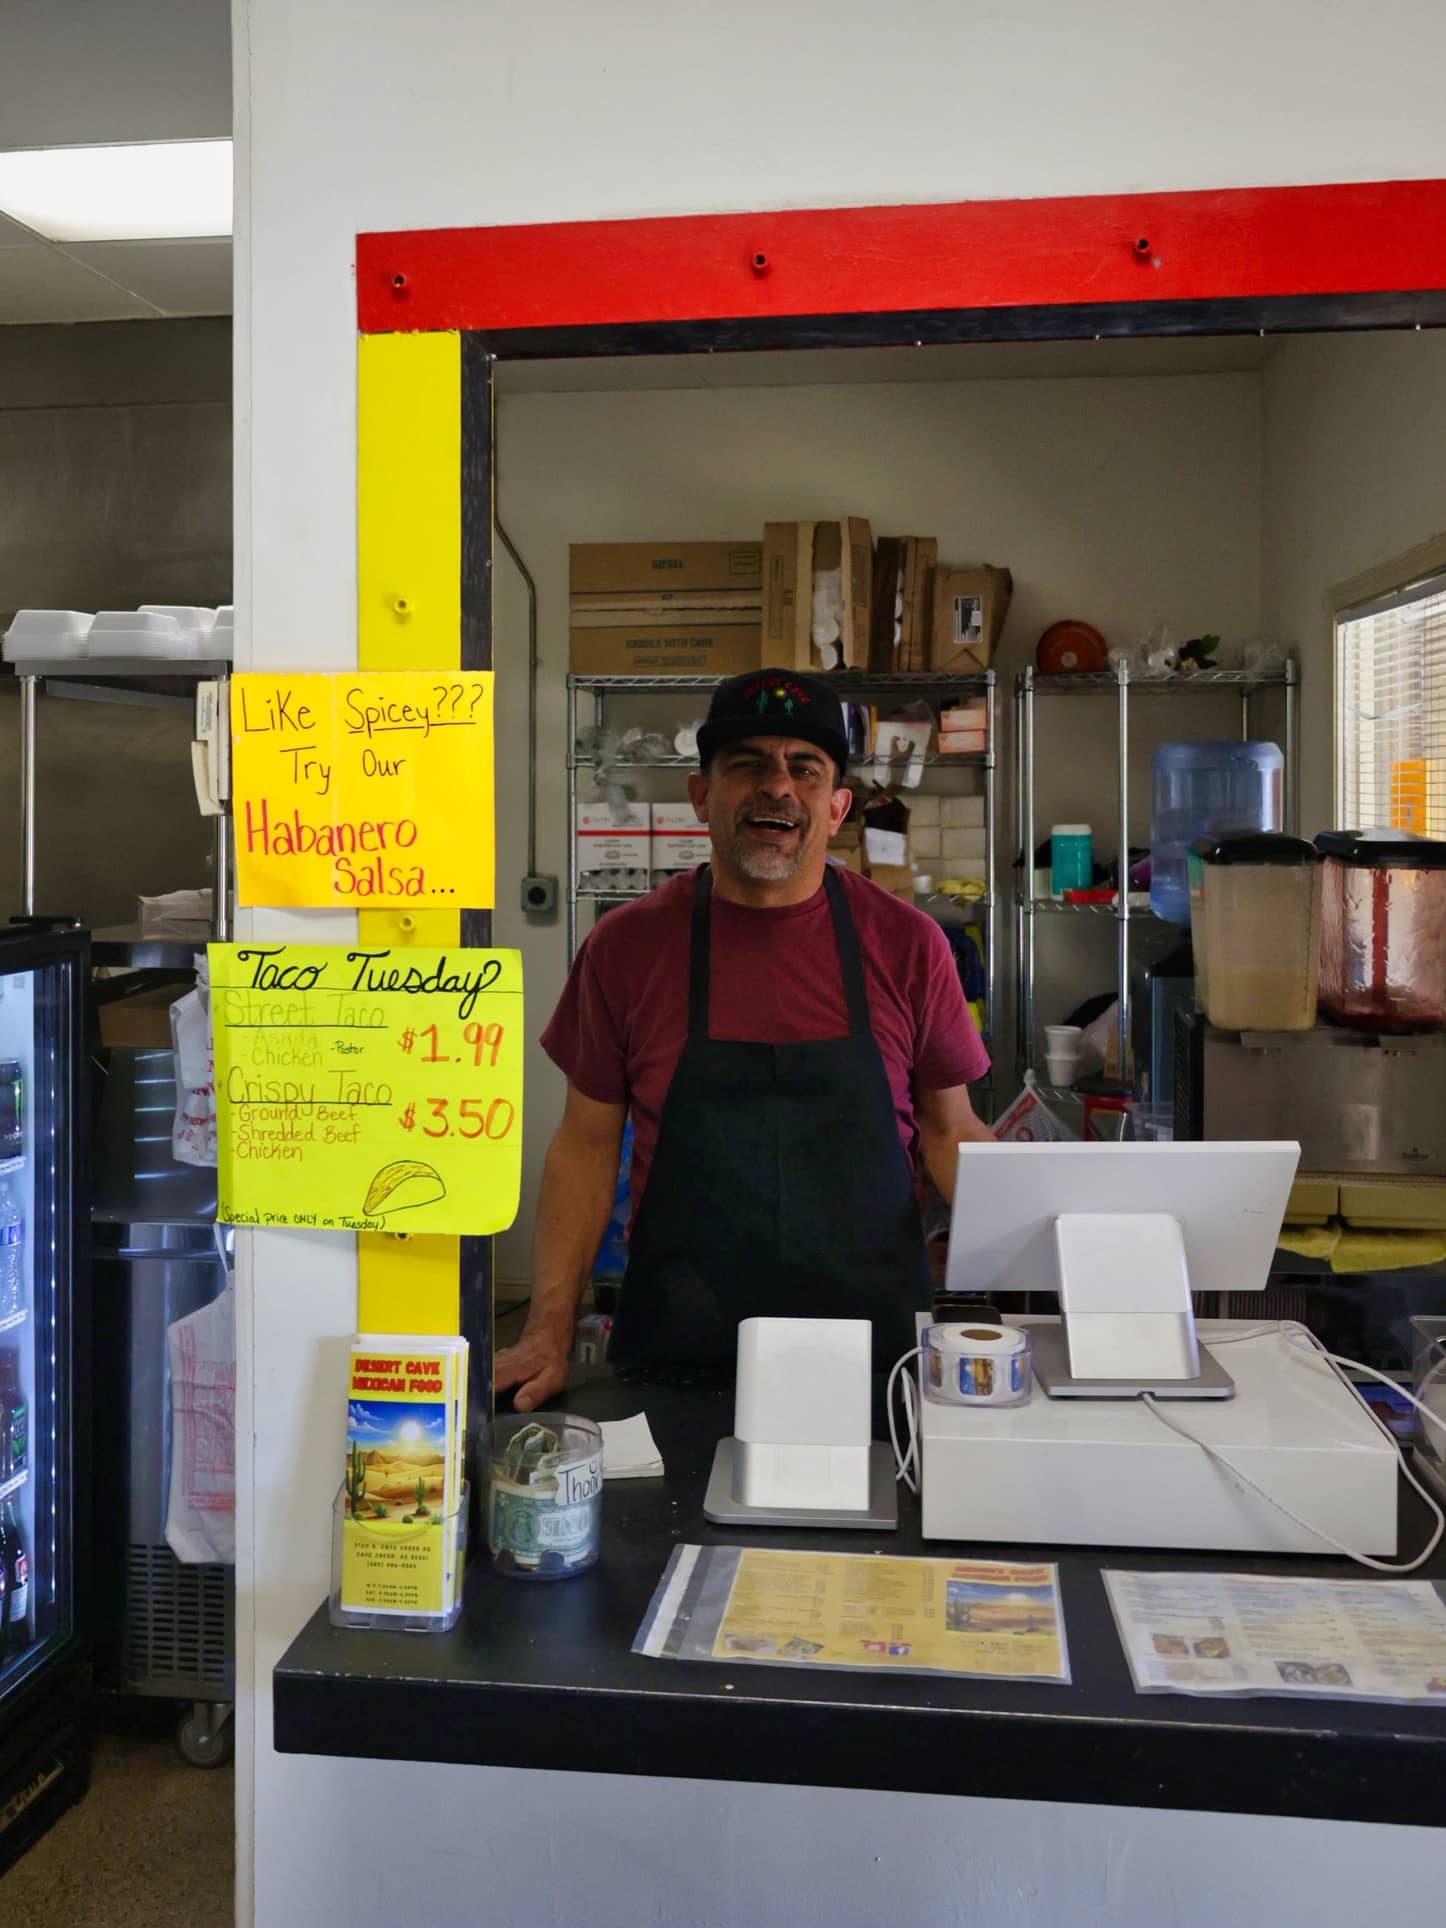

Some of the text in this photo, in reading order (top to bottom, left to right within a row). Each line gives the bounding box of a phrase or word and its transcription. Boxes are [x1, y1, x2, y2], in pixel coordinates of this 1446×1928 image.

[344, 683, 484, 739] Spicey???
[279, 745, 407, 795] Try Our
[245, 798, 417, 857] Habanero
[237, 945, 502, 1020] Taco Tuesday
[223, 989, 385, 1026] Street Taco
[397, 1021, 505, 1067] $1.99
[226, 1065, 393, 1117] Crispy Taco
[316, 1103, 358, 1121] Beef
[323, 1125, 362, 1144] Beef
[398, 1097, 516, 1140] $3.50
[294, 1211, 317, 1226] ONLY
[322, 1217, 335, 1227] on
[351, 1376, 443, 1393] MEXICAN FOOD
[355, 1358, 441, 1375] DESERT CAVE
